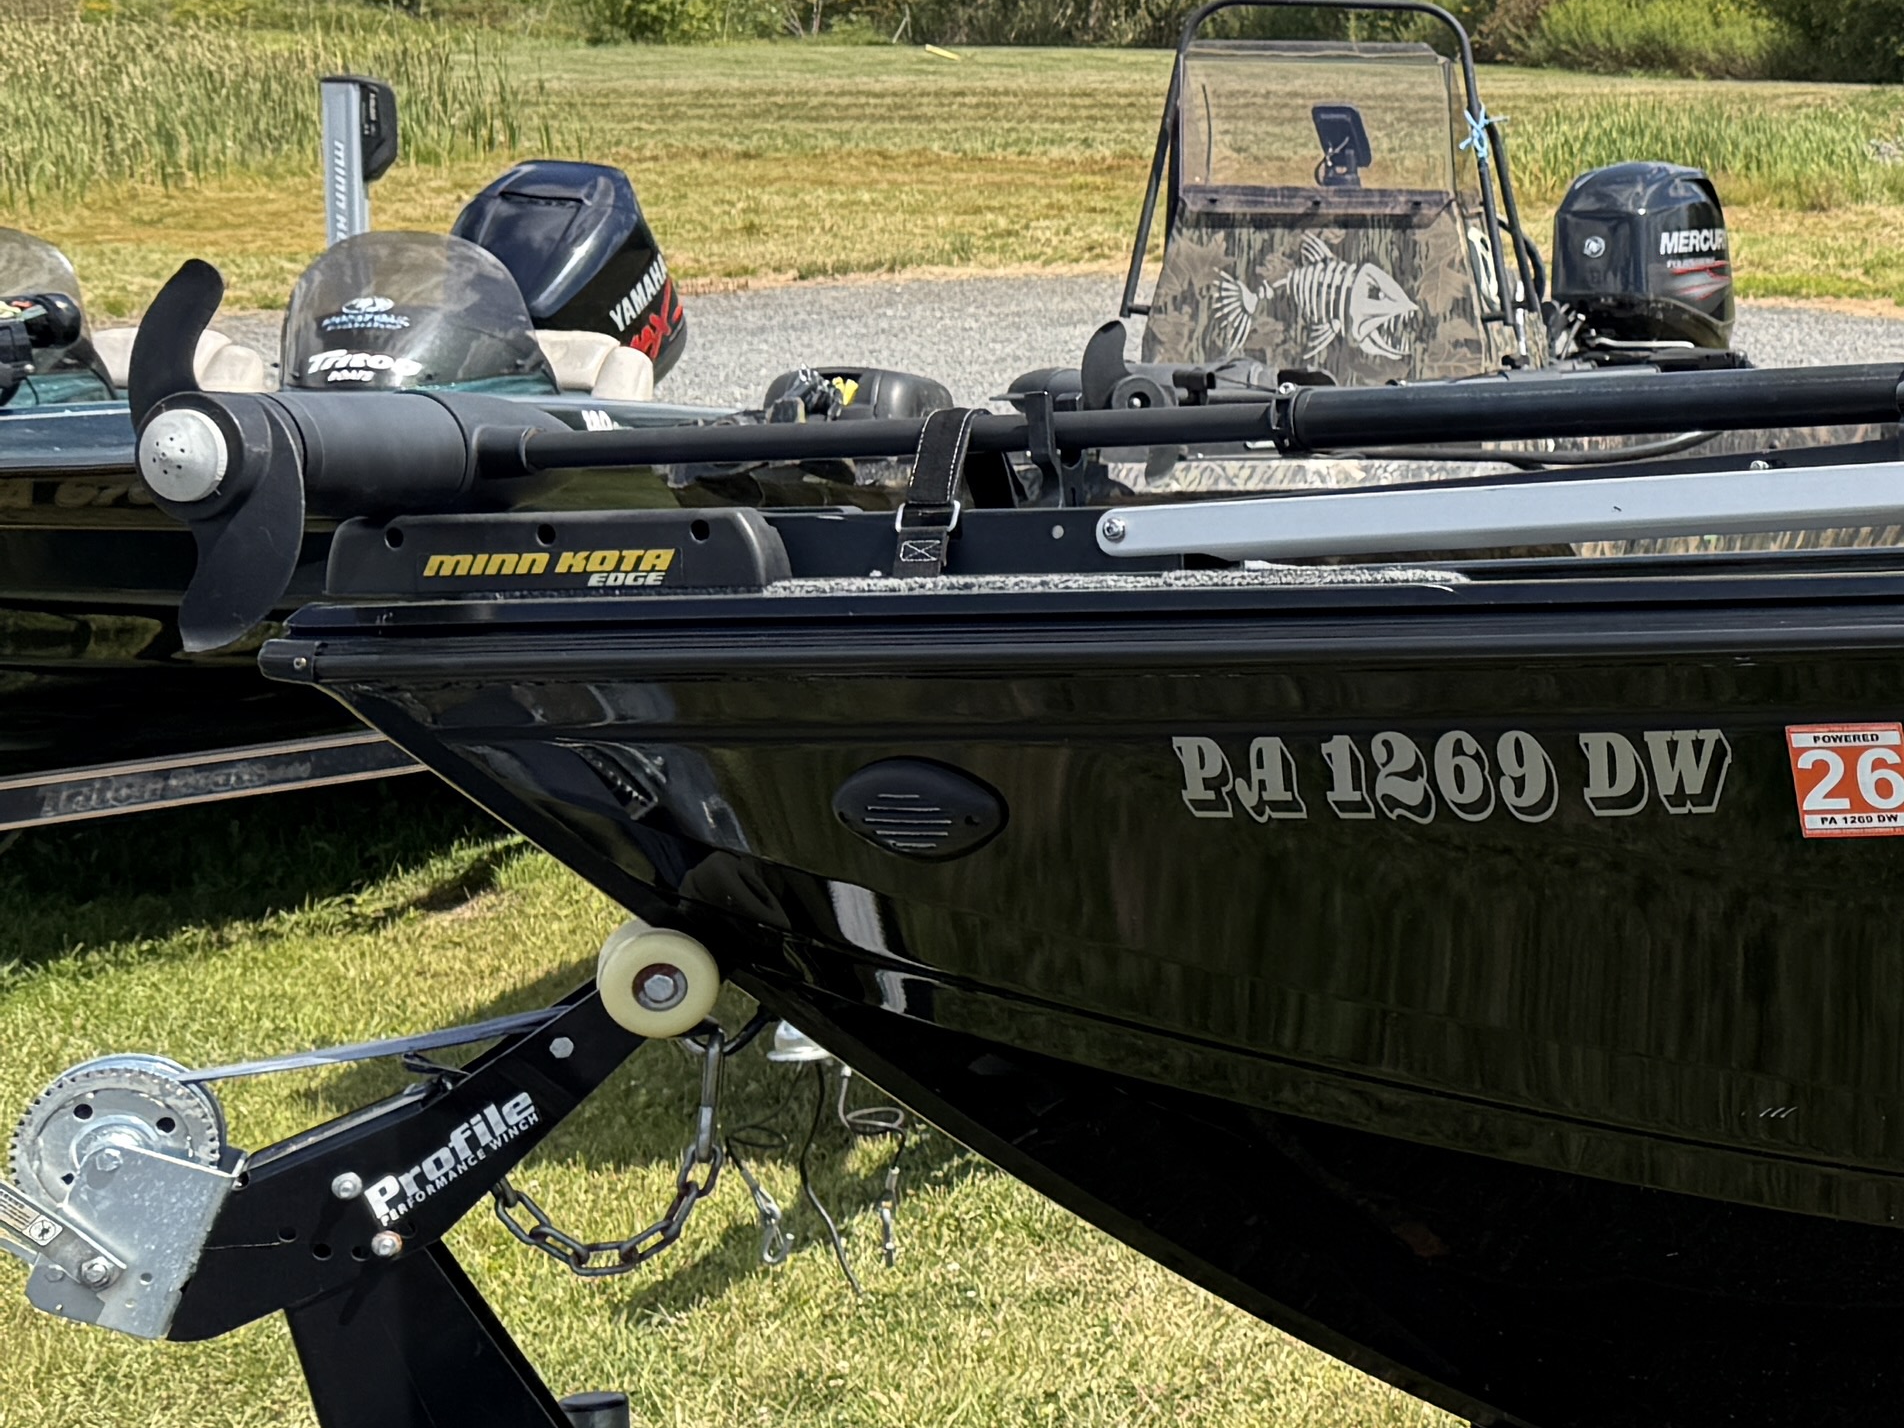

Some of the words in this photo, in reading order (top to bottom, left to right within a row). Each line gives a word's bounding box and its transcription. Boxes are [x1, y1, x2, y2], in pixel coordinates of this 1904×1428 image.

[423, 552, 550, 577] MINN
[554, 548, 676, 573] KOTA
[587, 571, 667, 587] EDGE
[1813, 733, 1880, 744] POWERED
[1171, 735, 1308, 824] PA
[1320, 729, 1560, 825] 1269
[1578, 728, 1732, 817] DW
[1820, 816, 1838, 826] PA
[1877, 813, 1899, 823] DW
[363, 1091, 536, 1219] Profile
[379, 1148, 487, 1227] PERFORMANCE
[489, 1112, 540, 1151] WINCH
